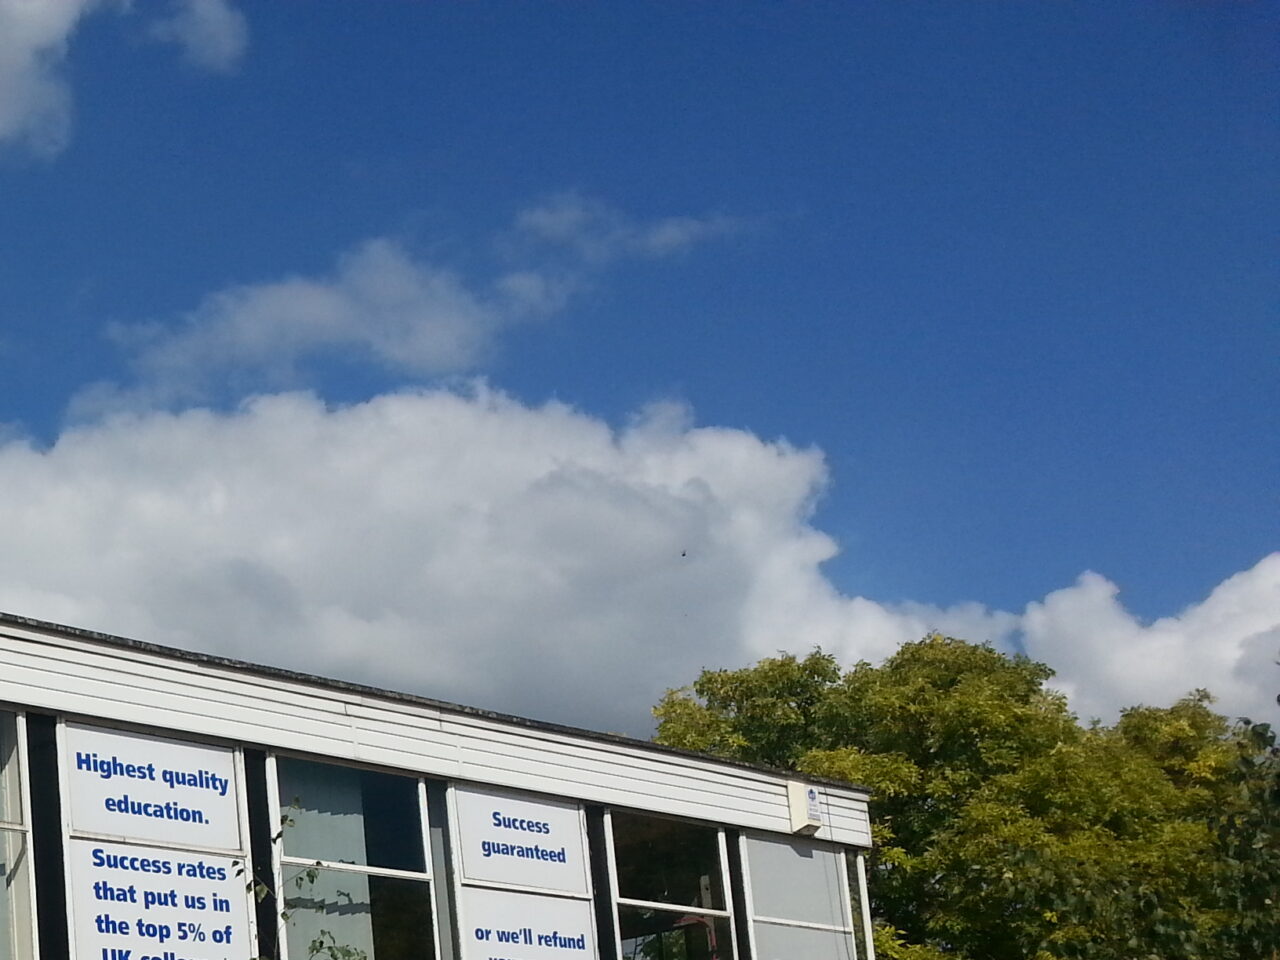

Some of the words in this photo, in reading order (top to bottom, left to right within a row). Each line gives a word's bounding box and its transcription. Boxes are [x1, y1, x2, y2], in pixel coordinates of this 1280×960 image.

[76, 752, 156, 781] Highest
[162, 768, 229, 796] quality
[105, 795, 209, 825] education.
[492, 811, 550, 834] Success
[92, 848, 171, 875] Success
[177, 861, 227, 881] rates
[482, 840, 566, 863] guaranteed
[93, 881, 137, 904] that
[143, 890, 177, 909] put
[184, 895, 206, 910] us
[212, 893, 230, 913] in
[95, 914, 130, 935] the
[136, 918, 170, 943] top
[177, 923, 206, 942] 5%
[212, 926, 232, 944] of
[475, 928, 491, 940] or
[497, 928, 532, 945] we'll
[537, 931, 585, 950] refund
